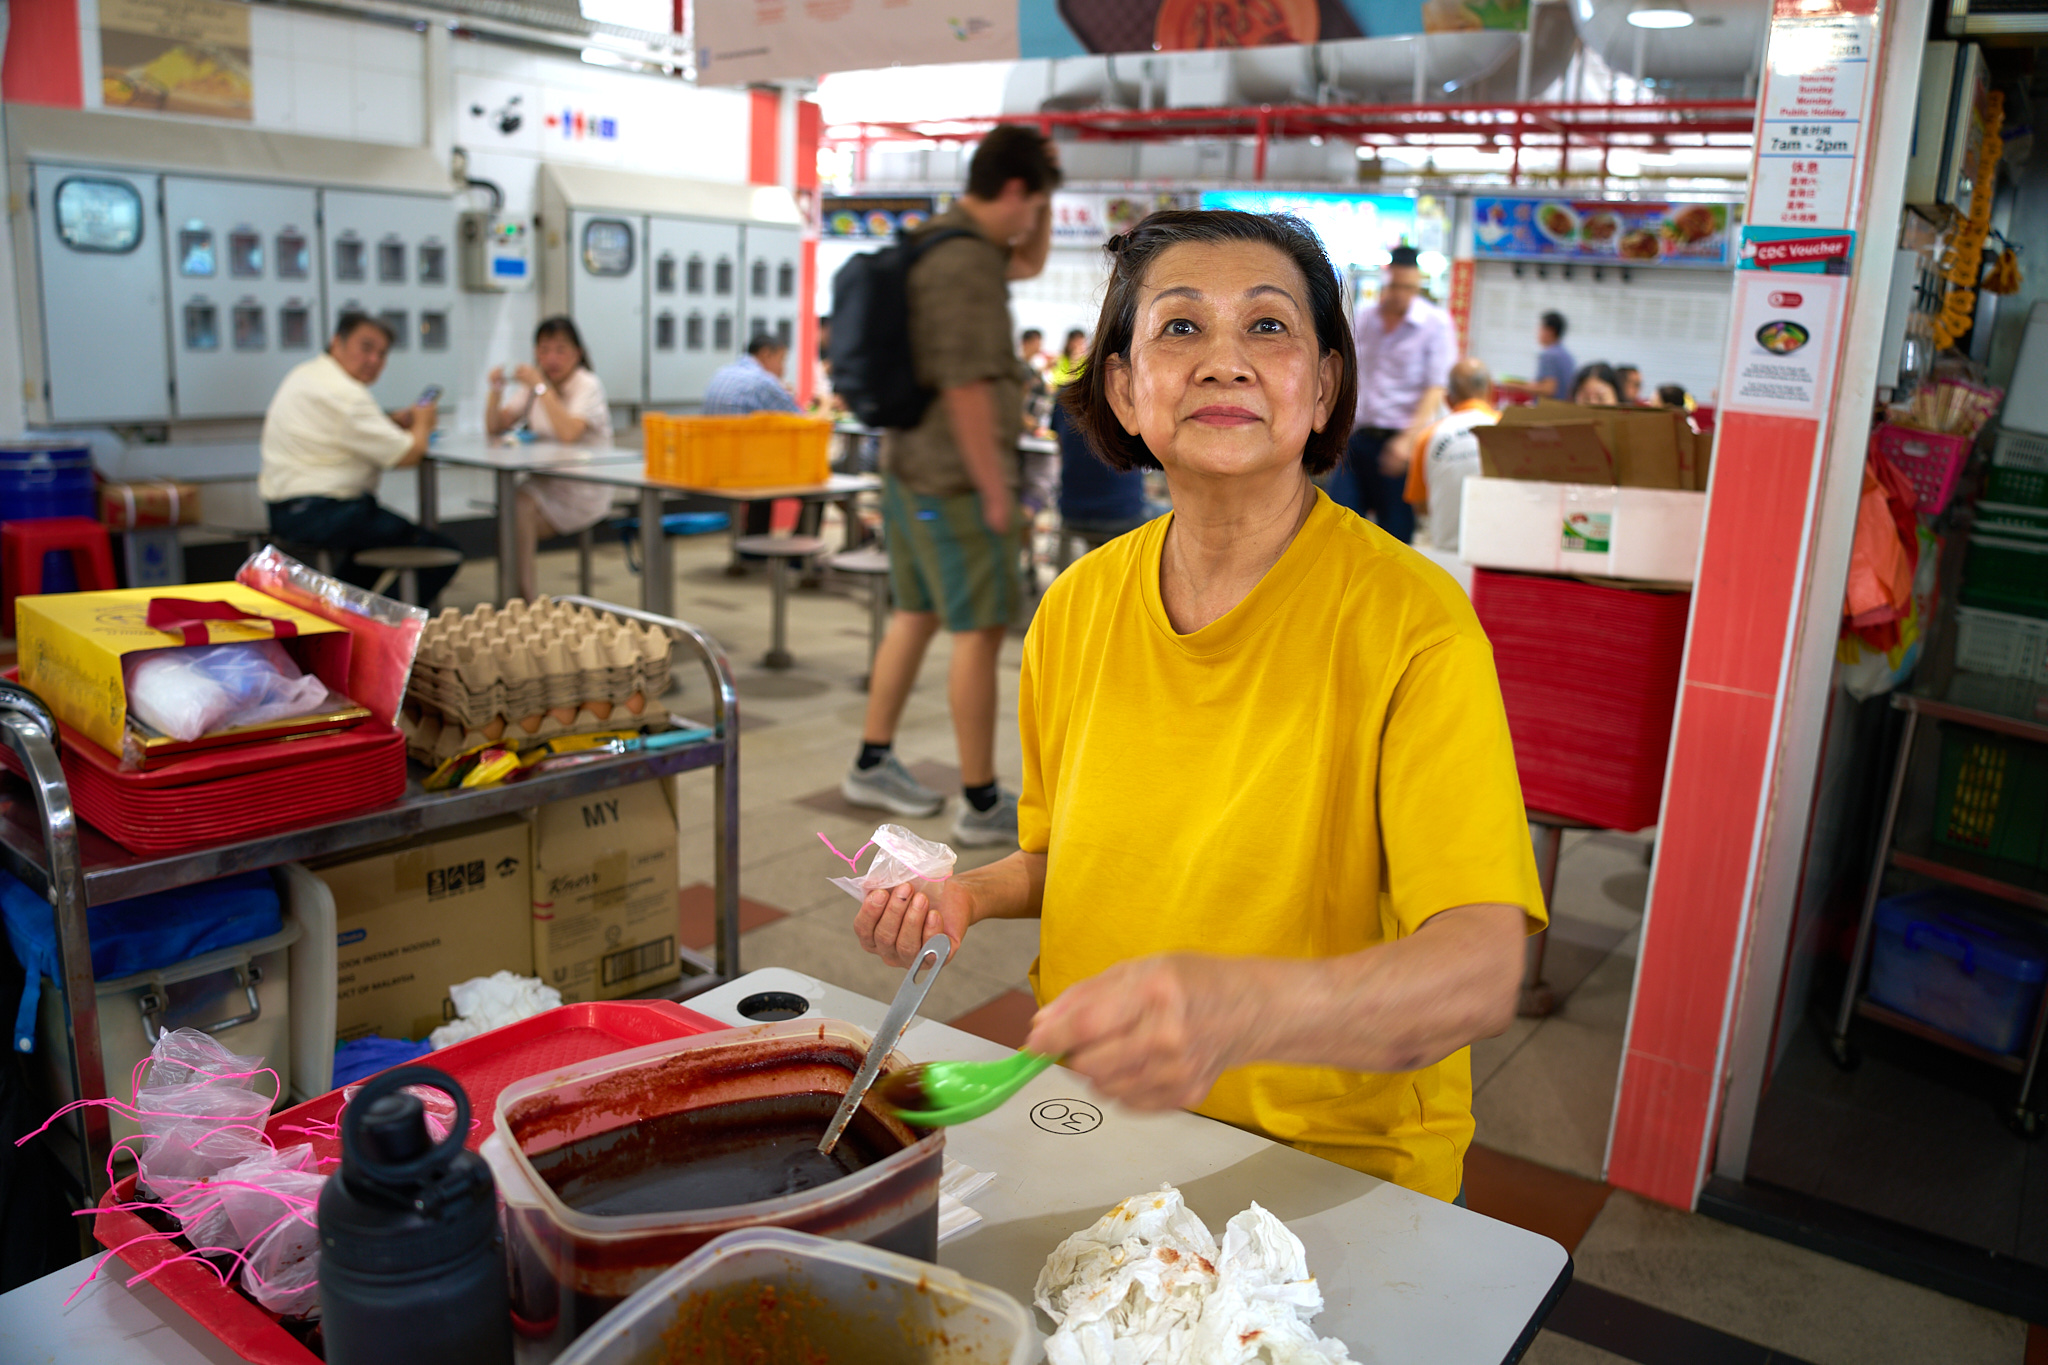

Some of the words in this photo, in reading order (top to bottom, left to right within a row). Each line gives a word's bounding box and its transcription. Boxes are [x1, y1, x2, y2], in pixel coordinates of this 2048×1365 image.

[1799, 86, 1833, 95] Sunday
[1796, 97, 1832, 106] Monday
[1780, 108, 1808, 116] Public
[1811, 108, 1846, 118] Holiday
[1772, 138, 1801, 150] 7am
[1815, 139, 1848, 153] 2pm
[1758, 244, 1786, 260] CDC
[1789, 241, 1843, 257] Voucher
[582, 799, 618, 828] MY
[363, 948, 399, 964] INSTANT
[402, 938, 441, 954] NOODLES
[358, 984, 369, 996] OF
[372, 973, 415, 990] MALAYSIA
[1039, 1103, 1095, 1131] 30
